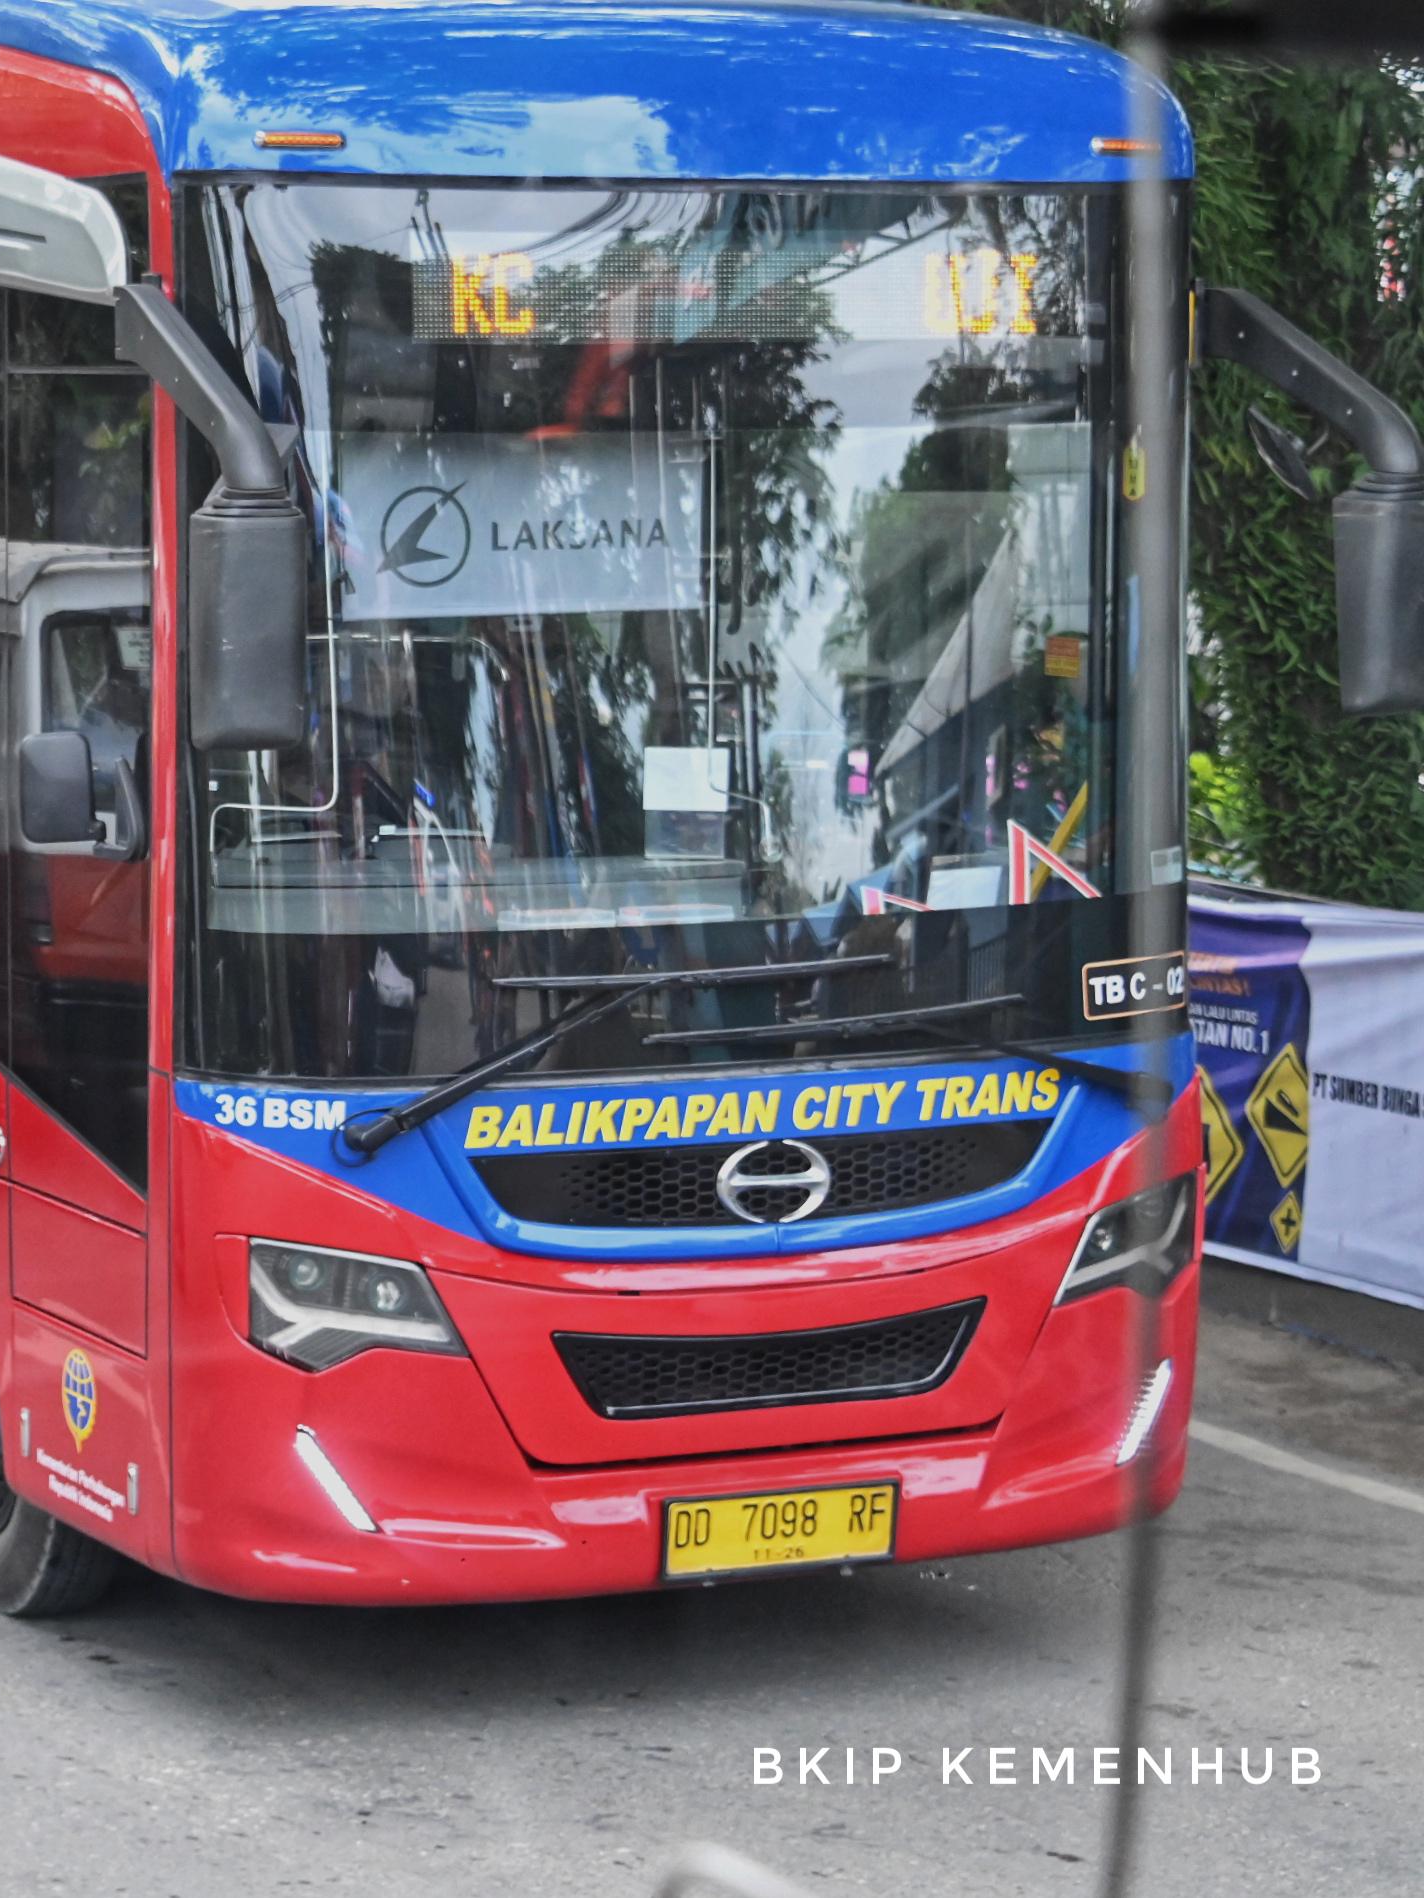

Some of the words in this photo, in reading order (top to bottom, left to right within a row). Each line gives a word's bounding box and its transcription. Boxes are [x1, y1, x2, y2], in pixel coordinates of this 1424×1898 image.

[214, 1093, 258, 1127] 36
[262, 1097, 347, 1131] BSM
[463, 1089, 782, 1150] BALIKPAPAN
[792, 1080, 907, 1132] CITY
[916, 1067, 1061, 1122] TRANS
[1312, 1072, 1327, 1099] PT
[1329, 1075, 1379, 1110] SUMBER
[675, 1507, 711, 1549] DD
[741, 1498, 819, 1542] 7098
[848, 1492, 888, 1534] RF
